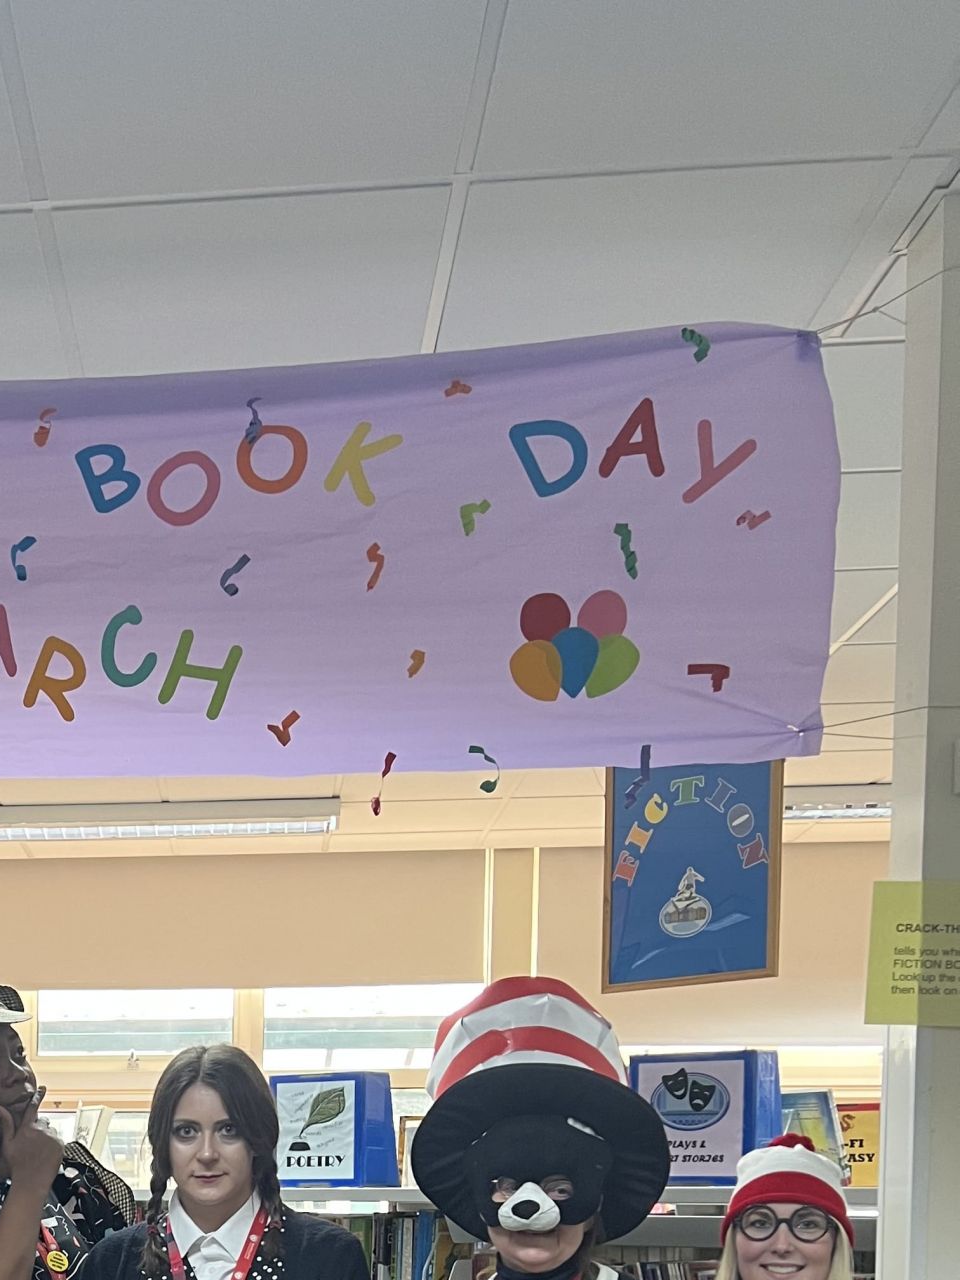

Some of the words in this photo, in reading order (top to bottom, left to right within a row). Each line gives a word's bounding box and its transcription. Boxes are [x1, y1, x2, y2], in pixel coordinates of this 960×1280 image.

[74, 421, 403, 527] BOOK
[509, 397, 757, 504] DAY
[613, 775, 769, 887] FICTION
[894, 945, 916, 956] tells
[920, 948, 939, 958] you
[893, 959, 942, 969] FICTION
[892, 972, 920, 982] Look
[922, 974, 936, 984] up
[939, 973, 955, 983] the
[891, 985, 915, 995] then
[286, 1155, 345, 1167] POETRY
[682, 1154, 724, 1163] STORIES
